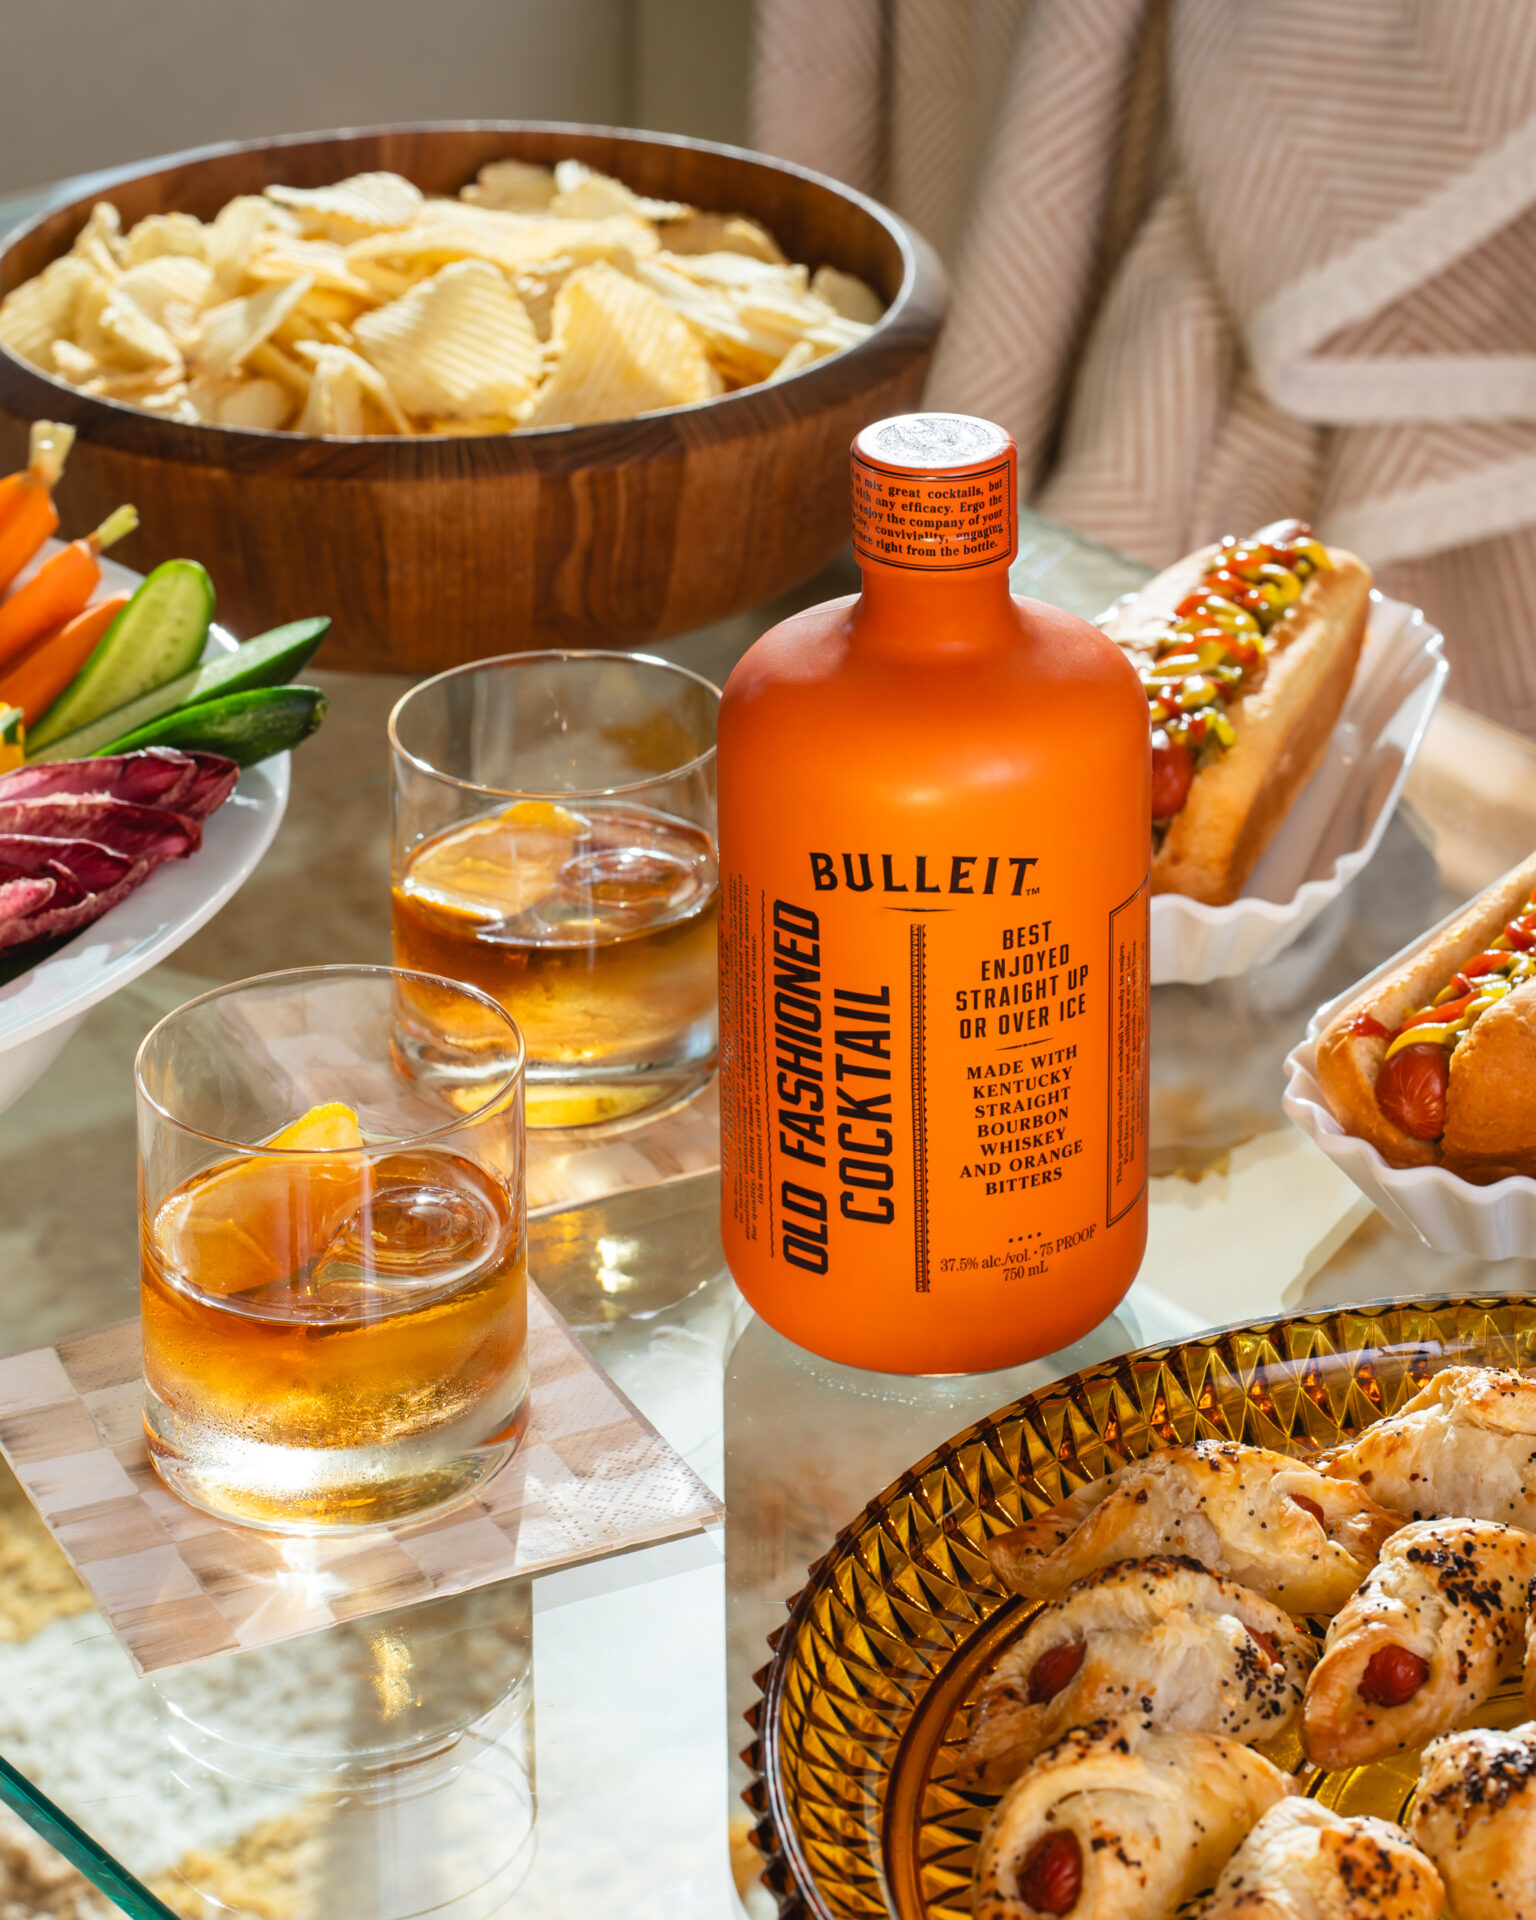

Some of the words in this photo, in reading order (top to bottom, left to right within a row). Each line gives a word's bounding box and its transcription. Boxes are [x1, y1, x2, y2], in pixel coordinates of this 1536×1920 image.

[864, 478, 882, 492] mix
[888, 487, 920, 498] great
[928, 486, 984, 499] cocktails,
[988, 479, 1002, 492] but
[875, 497, 895, 511] any
[901, 502, 954, 516] efficacy.
[960, 501, 985, 513] Ergo
[989, 494, 1002, 506] the
[859, 503, 884, 522] enjoy
[887, 513, 905, 525] the
[909, 518, 965, 531] company
[968, 514, 980, 526] of
[982, 509, 1003, 526] your
[875, 525, 949, 545] conviviality,
[956, 523, 1003, 542] engaging
[876, 538, 903, 553] right
[906, 545, 936, 556] from
[941, 546, 959, 556] the
[963, 540, 998, 555] bottle.
[809, 852, 1039, 896] BULLEIT
[1002, 920, 1052, 950] BEST
[981, 943, 1070, 981] ENJOYED
[955, 974, 1059, 1011] STRAIGHT
[1068, 964, 1089, 991] UP
[959, 1017, 987, 1039] OR
[998, 1005, 1049, 1035] OVER
[1060, 993, 1086, 1022] ICE
[773, 898, 827, 1168] FASHIONED
[966, 1060, 1024, 1080] MADE
[1031, 1044, 1078, 1070] WITH
[972, 1066, 1073, 1099] KENTUCKY
[834, 984, 895, 1225] COCKTAIL
[974, 1086, 1071, 1119] STRAIGHT
[977, 1106, 1070, 1138] BOURBON
[980, 1126, 1067, 1157] WHISKEY
[959, 1161, 1001, 1179] AND
[1009, 1139, 1083, 1172] ORANGE
[985, 1166, 1063, 1196] BITTERS
[781, 1179, 828, 1276] OLD
[940, 1256, 979, 1273] 37.5%
[981, 1249, 1032, 1270] alc./vol.
[1039, 1242, 1055, 1257] 75
[1056, 1223, 1097, 1253] PROOF
[1003, 1266, 1025, 1282] 750
[1028, 1260, 1048, 1278] mL
